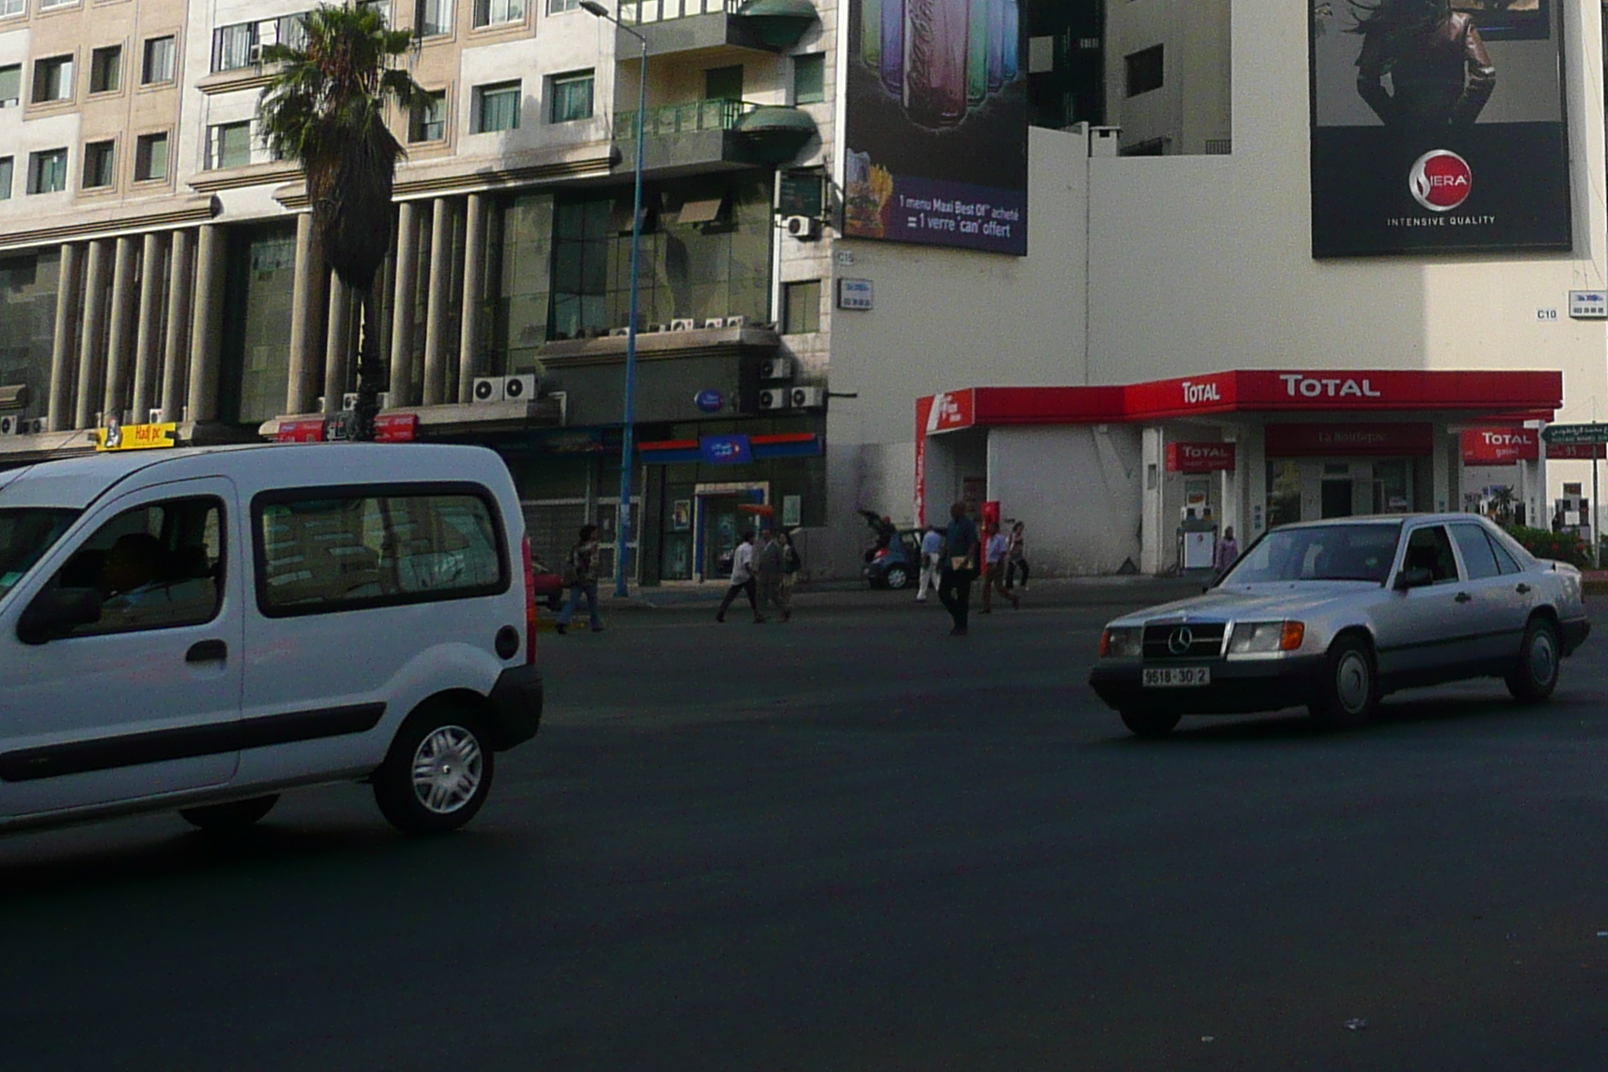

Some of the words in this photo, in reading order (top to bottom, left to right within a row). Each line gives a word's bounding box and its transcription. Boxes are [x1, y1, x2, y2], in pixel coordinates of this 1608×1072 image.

[899, 194, 904, 207] 1
[906, 198, 932, 211] menu
[932, 198, 954, 213] Maxi
[955, 200, 975, 215] Best
[920, 212, 925, 227] 1
[927, 217, 956, 231] verre
[983, 220, 1011, 238] offert
[1387, 217, 1445, 227] INTENSIVE
[1449, 215, 1495, 225] QUALITY
[1182, 381, 1220, 403] TOTAL
[1279, 374, 1381, 397] TOTAL
[1482, 432, 1532, 445] TOTAL
[1182, 445, 1228, 458] TOTAL
